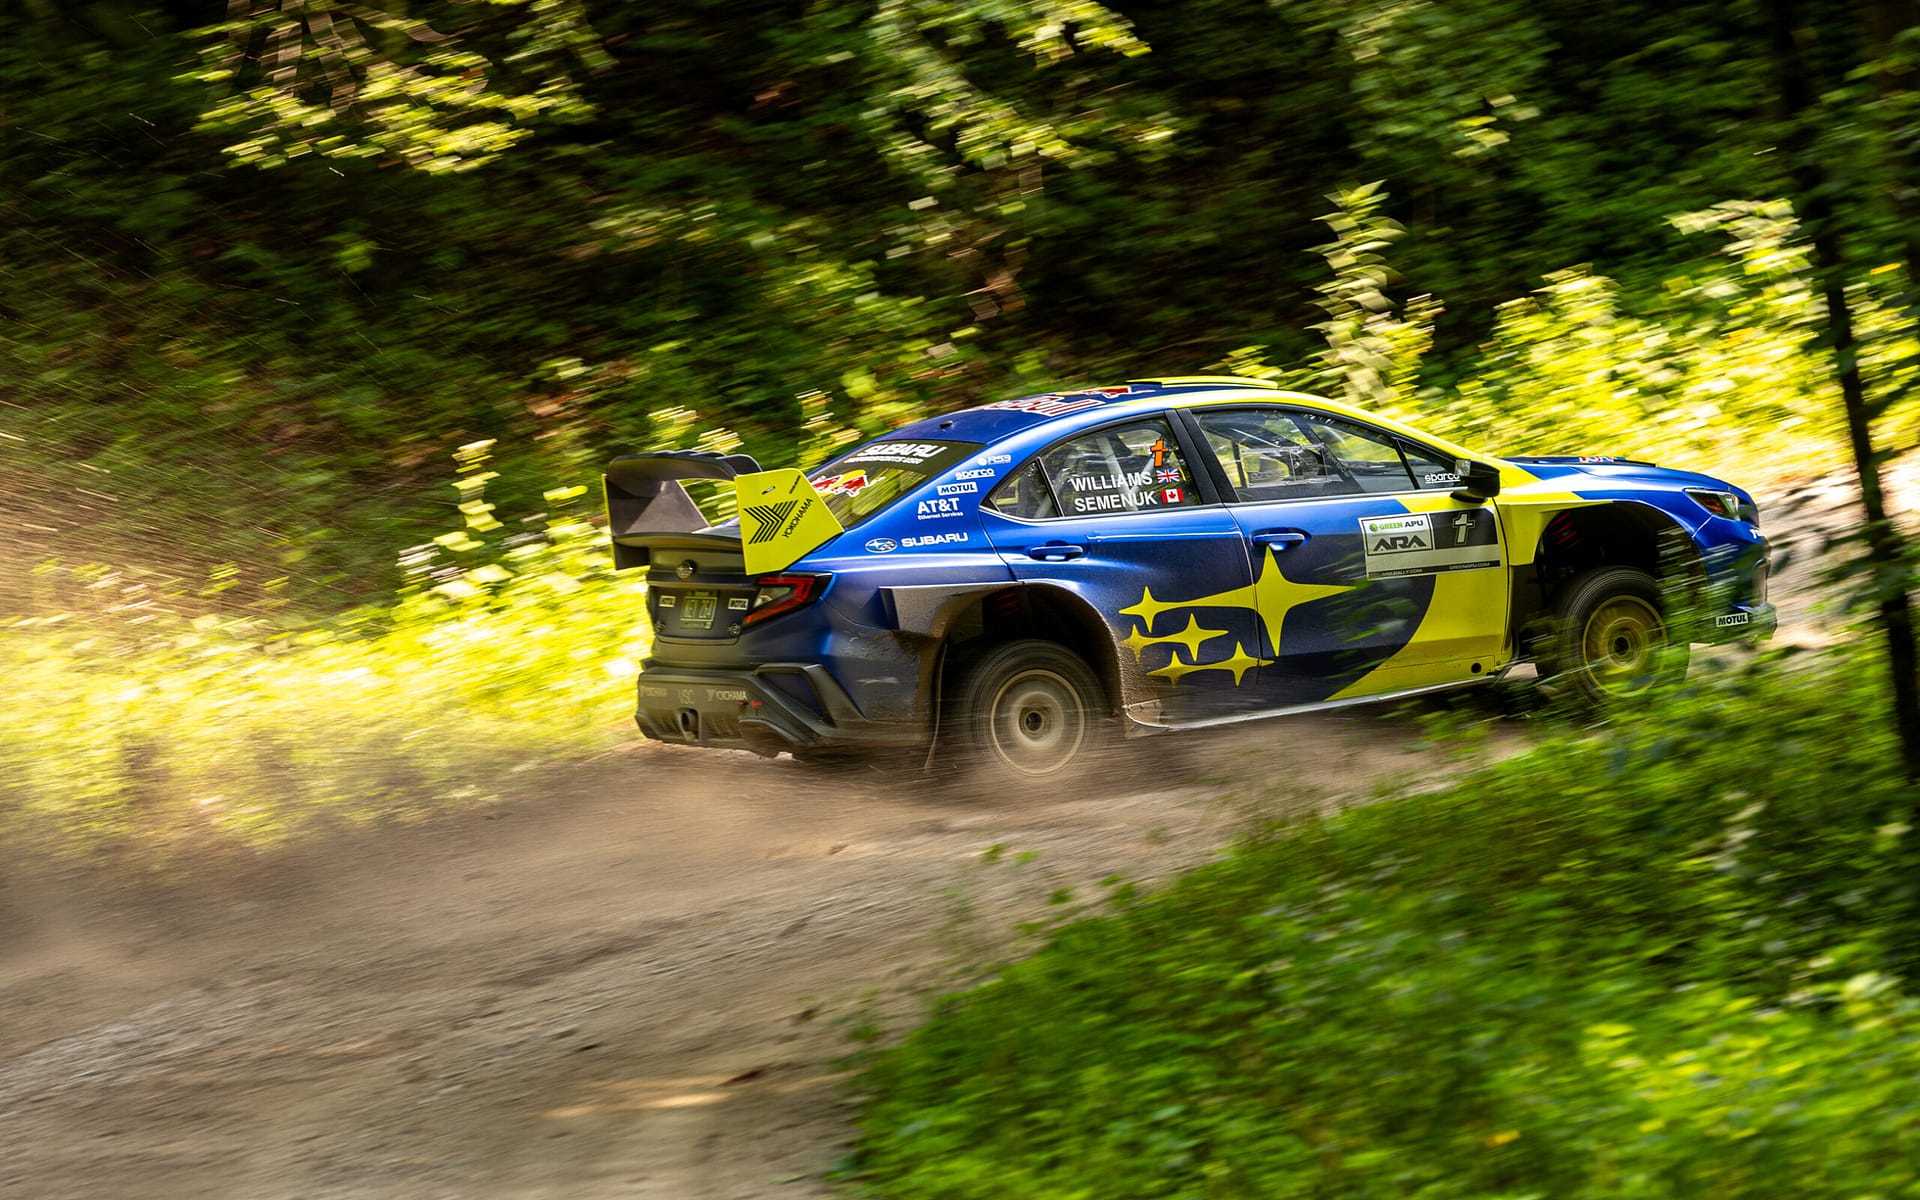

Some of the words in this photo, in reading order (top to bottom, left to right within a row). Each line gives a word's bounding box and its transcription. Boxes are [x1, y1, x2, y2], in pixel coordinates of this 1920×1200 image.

[857, 444, 948, 458] SUBARU
[955, 468, 995, 481] sparco
[1424, 471, 1460, 484] sparco
[941, 483, 976, 493] MOTUL
[1067, 472, 1153, 492] WILLIAMS
[917, 498, 960, 515] AT&T
[1074, 491, 1158, 512] SEMENUK
[782, 498, 814, 538] YOKOHAMA
[1379, 522, 1403, 530] GREEN
[1404, 520, 1424, 528] APU
[901, 532, 968, 547] SUBARU
[1373, 535, 1427, 552] ARA
[1719, 614, 1747, 626] MOTUL
